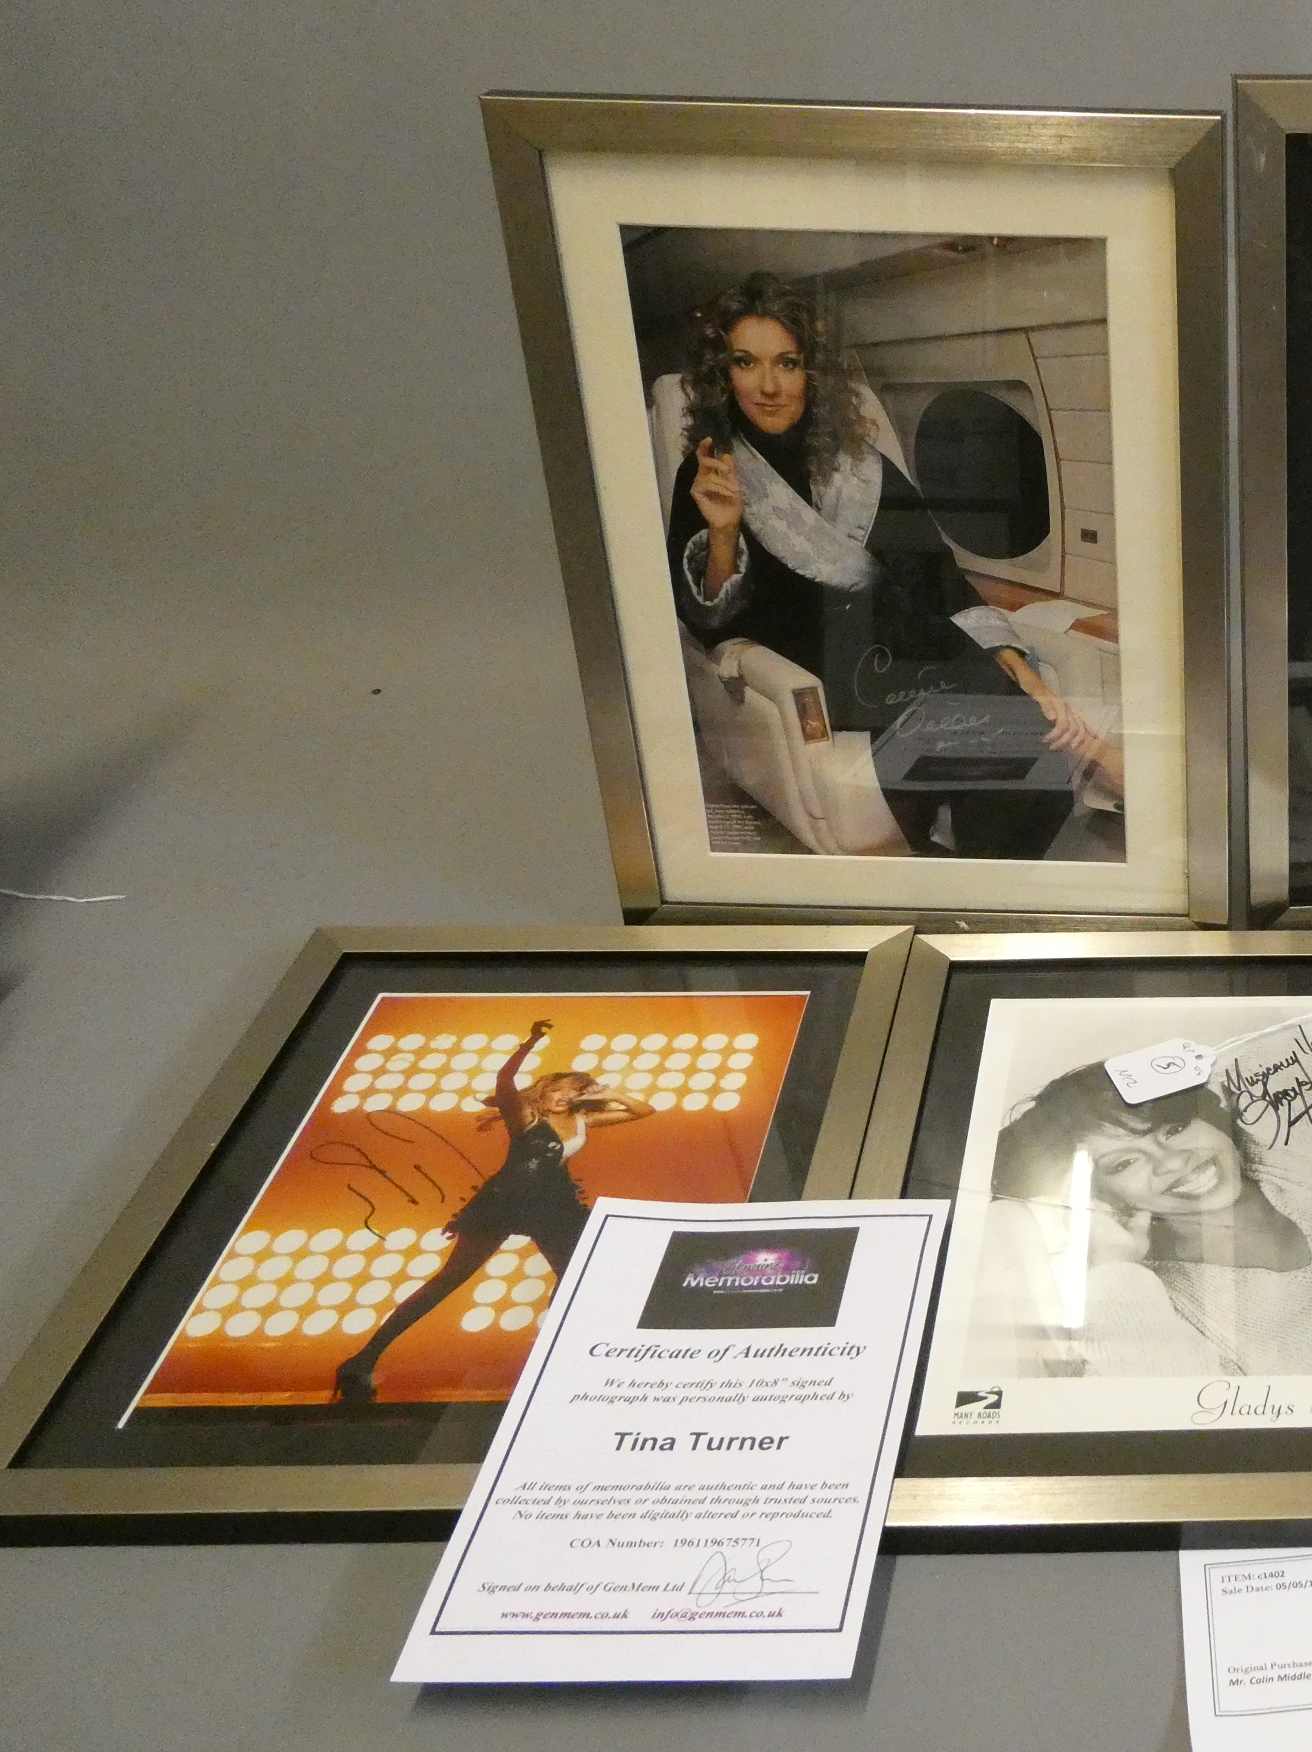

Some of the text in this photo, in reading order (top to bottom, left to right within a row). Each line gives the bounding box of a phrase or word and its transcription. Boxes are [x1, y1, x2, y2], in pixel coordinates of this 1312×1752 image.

[682, 1270, 819, 1288] Memorabilia
[588, 1341, 867, 1363] Certificate of Authenticity
[603, 1378, 625, 1388] We
[627, 1378, 673, 1391] hereby
[675, 1379, 718, 1391] certify
[719, 1379, 744, 1389] this
[789, 1376, 835, 1389] signed
[569, 1390, 854, 1405] photograph was personally autographed by
[1190, 1380, 1296, 1425] Gladys
[953, 1410, 1001, 1420] MANY ROADS
[613, 1431, 790, 1452] Tina Turner
[514, 1480, 850, 1494] All items of memorabilia are authentic and have been
[495, 1494, 860, 1508] collected by ourselves or obtained through trusted sources.
[512, 1508, 833, 1521] No items have been digitally altered or reproduced.
[569, 1537, 762, 1549] COA Number: 196119675771
[1221, 1570, 1286, 1583] ITEM: c1402
[477, 1581, 686, 1594] Signed on behalf of GenMem Ltd
[1221, 1587, 1243, 1596] Sale
[1245, 1584, 1274, 1593] Date:
[499, 1607, 785, 1622] www.genmem.co.uk info@genmem.co.uk
[1227, 1663, 1268, 1676] Original
[1229, 1677, 1246, 1687] Mr.
[1249, 1675, 1275, 1685] Colin
